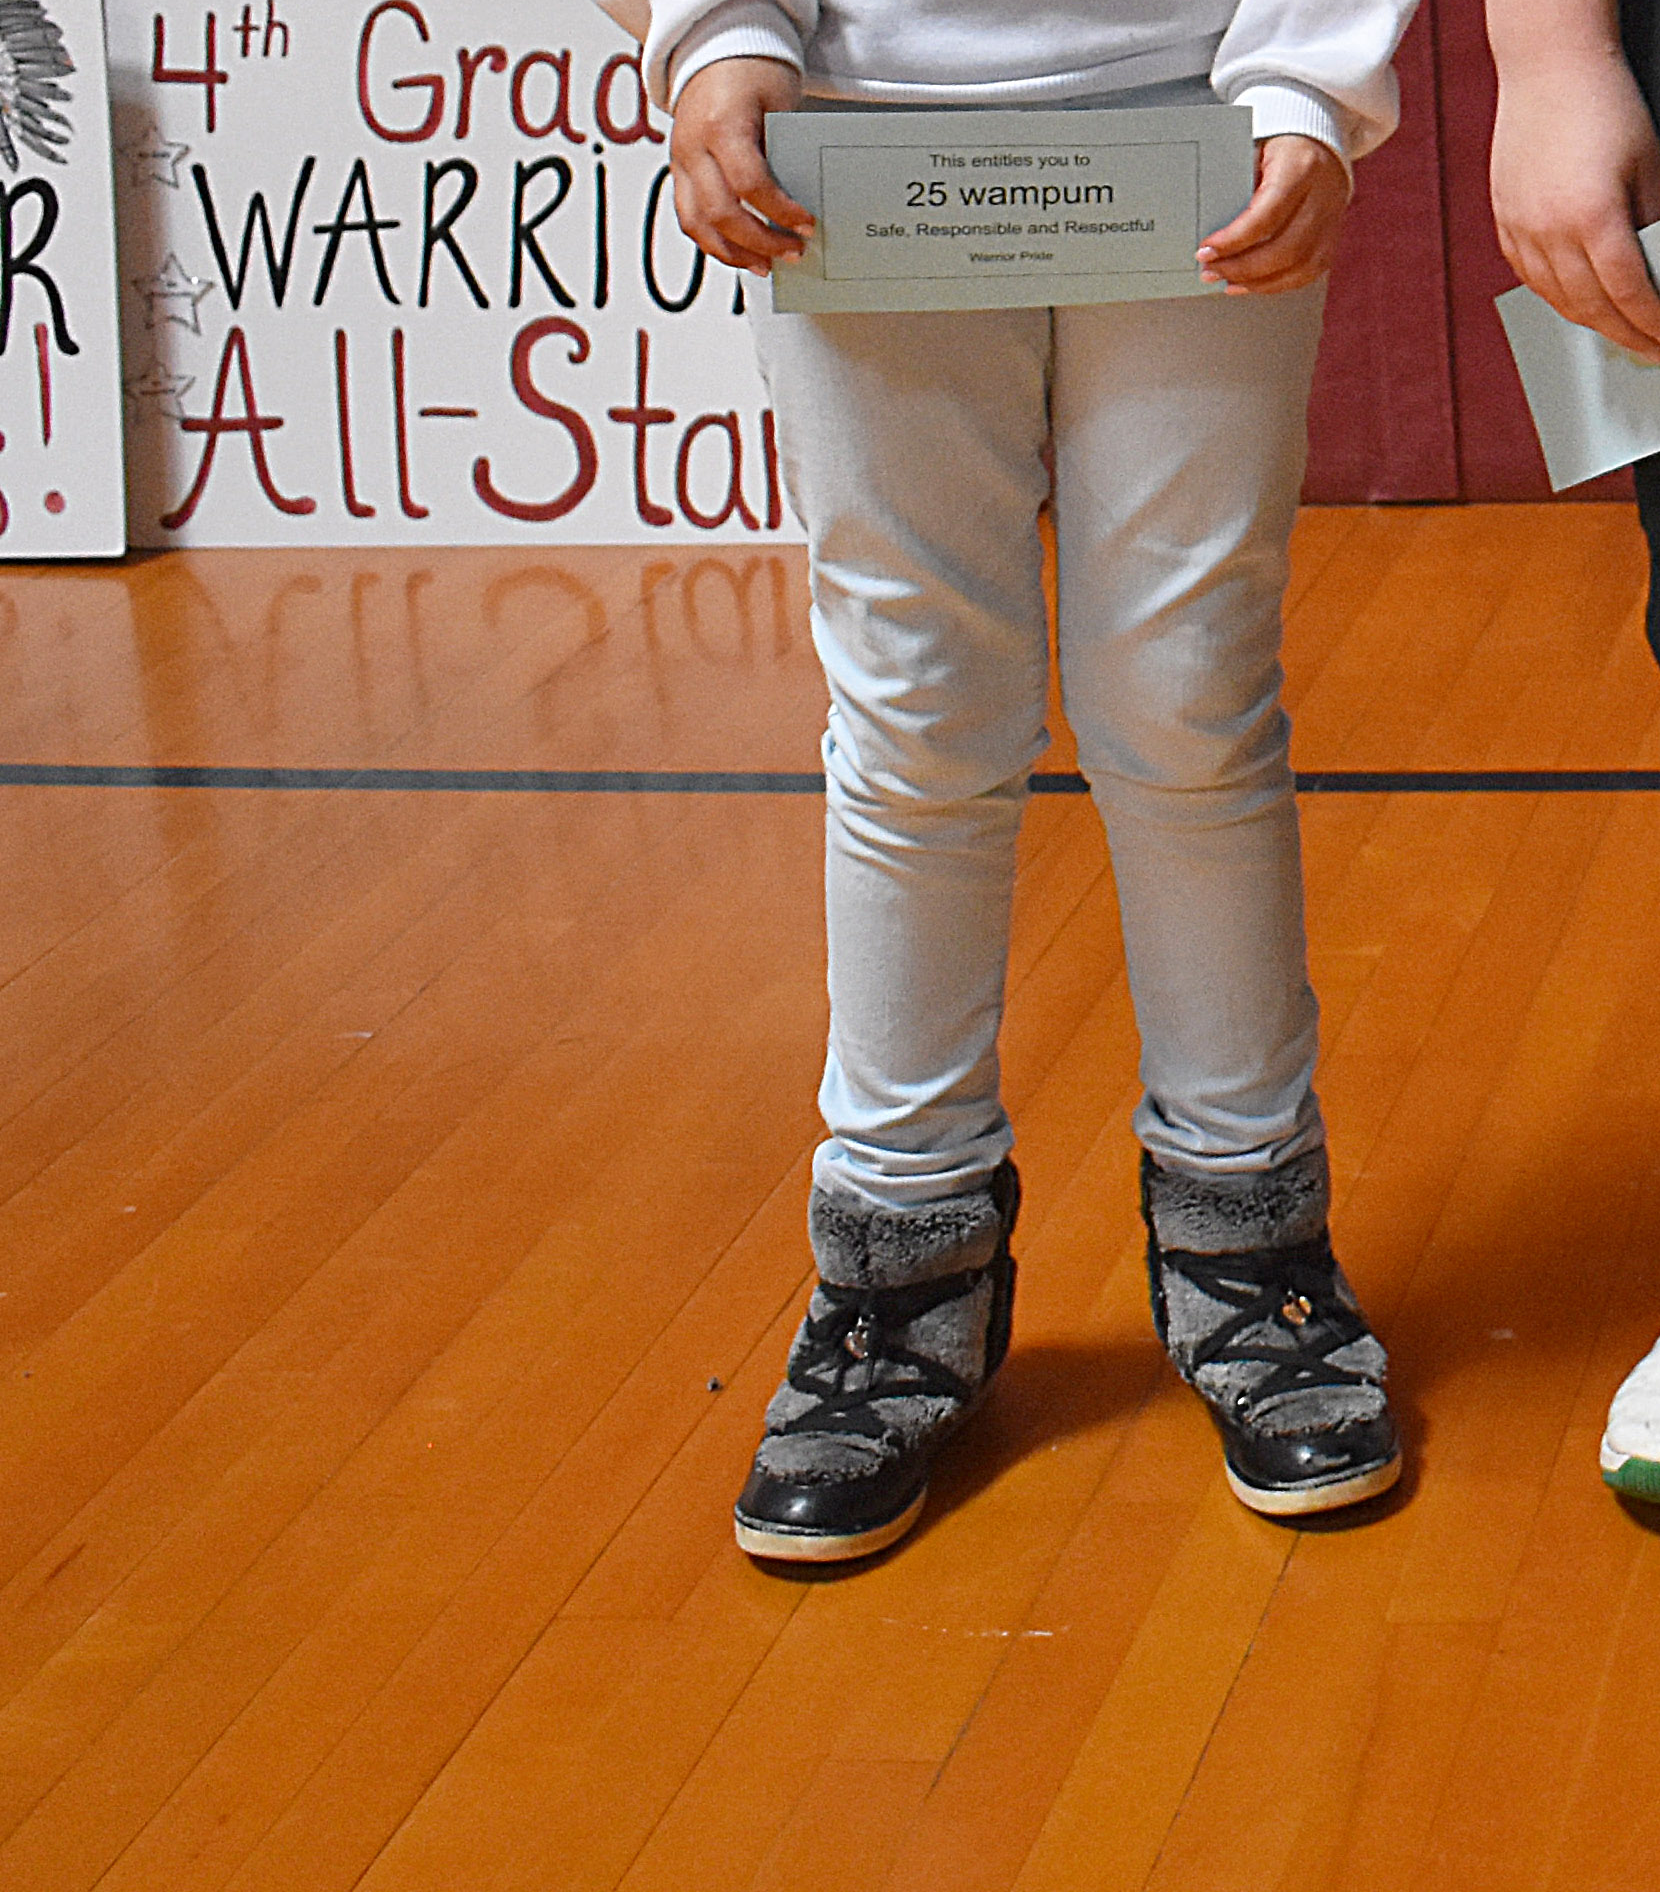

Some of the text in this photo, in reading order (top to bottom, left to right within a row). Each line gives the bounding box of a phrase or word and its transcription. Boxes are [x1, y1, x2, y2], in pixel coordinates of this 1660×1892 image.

[930, 153, 1090, 170] This entitles you to
[906, 182, 1114, 211] 25 wampum
[915, 221, 1023, 240] Responsible
[1027, 220, 1060, 236] and
[1064, 218, 1155, 236] Respectful
